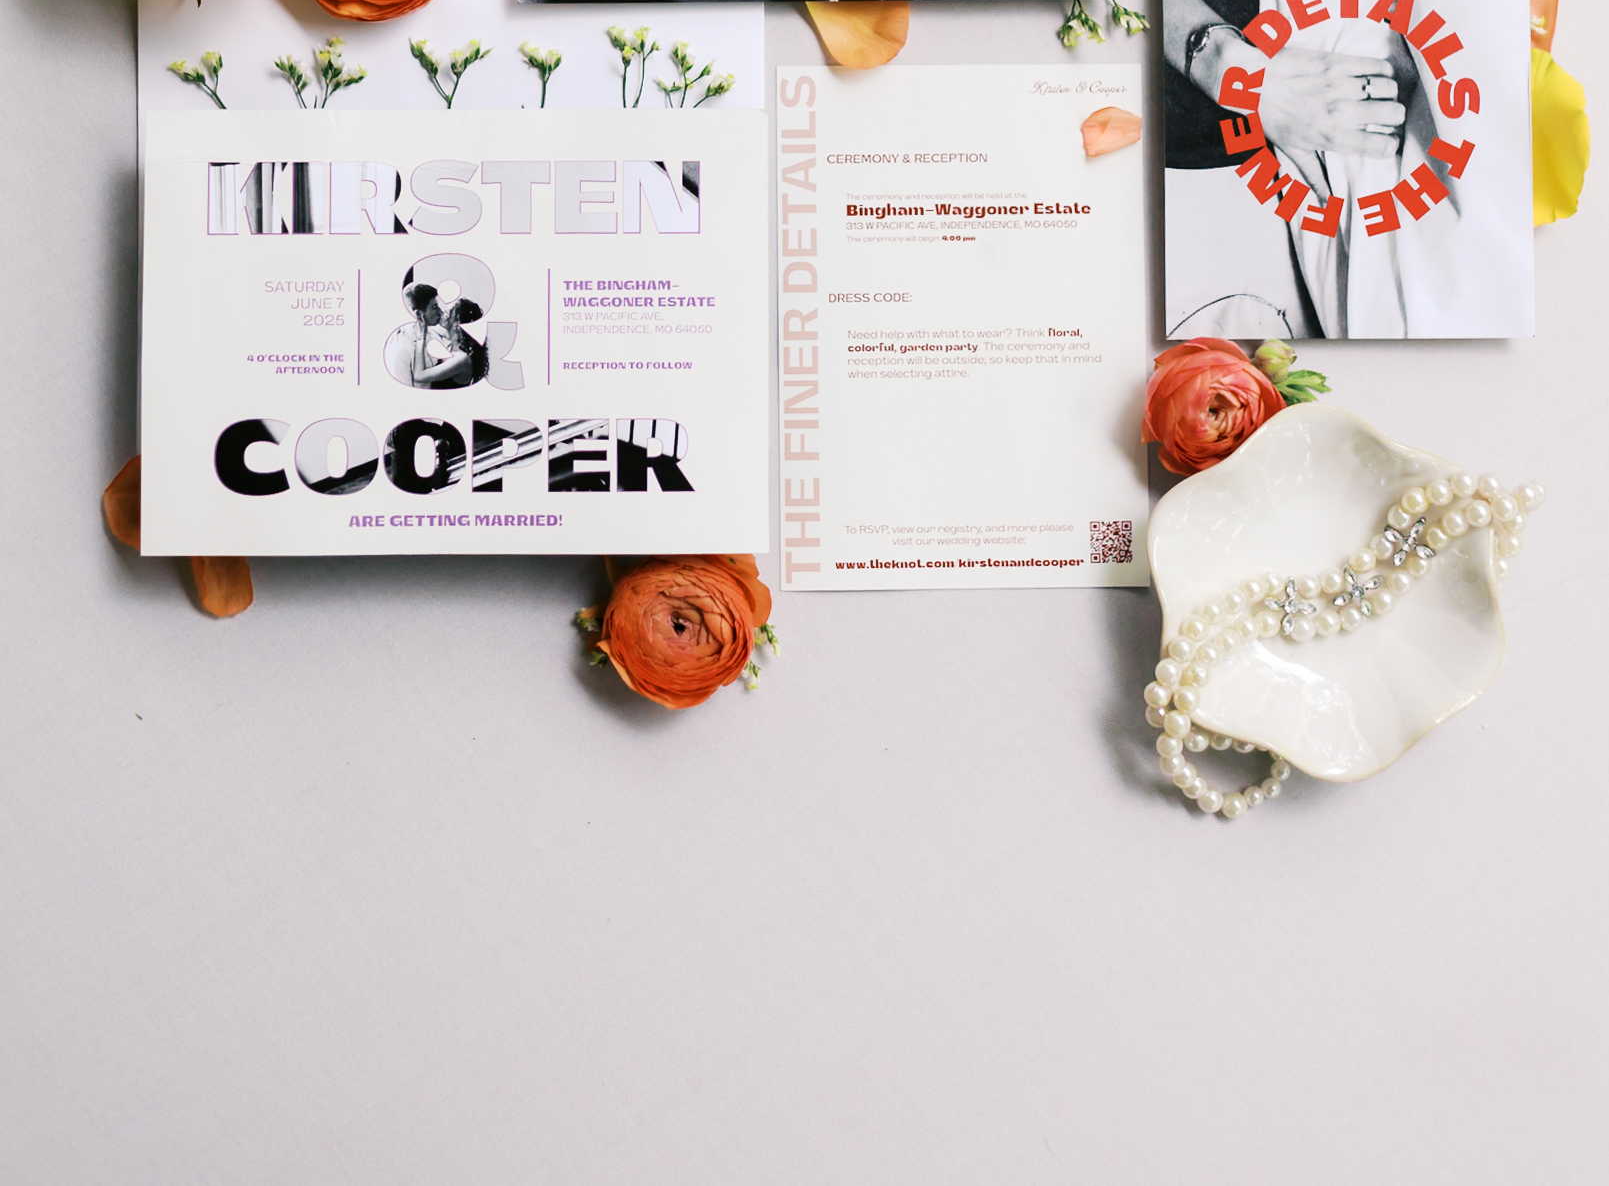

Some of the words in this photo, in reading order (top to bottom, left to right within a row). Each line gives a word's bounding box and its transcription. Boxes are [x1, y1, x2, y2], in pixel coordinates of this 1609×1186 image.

[1029, 81, 1071, 95] Kirsten
[1075, 81, 1087, 94] &
[1089, 80, 1127, 97] Cooper
[1217, 66, 1344, 238] FINER
[827, 154, 899, 164] CEREMONY
[902, 154, 911, 163] &
[914, 153, 988, 163] RECEPTION
[780, 75, 818, 293] DETAILS
[1357, 136, 1475, 237] THE
[206, 159, 700, 235] KIRSTEN
[921, 192, 960, 201] reception
[962, 192, 973, 200] will
[1014, 191, 1027, 199] the
[1034, 202, 1091, 214] Estate
[846, 222, 863, 230] 313
[865, 222, 874, 230] W
[876, 221, 915, 230] PACIFIC
[917, 221, 939, 230] AVE,
[940, 220, 1022, 230] INDEPENDENCE,
[1025, 220, 1041, 229] MO
[1043, 220, 1077, 229] 64050
[863, 236, 903, 244] ceremony
[918, 235, 939, 243] begin
[265, 281, 345, 292] SATURDAY
[563, 281, 593, 290] THE
[291, 298, 332, 309] JUNE
[336, 298, 345, 309] 7
[563, 297, 654, 307] WAGGONER
[658, 297, 715, 307] ESTATE
[829, 293, 870, 303] DRESS
[873, 293, 912, 302] CODE:
[303, 315, 345, 326] 2025
[383, 253, 525, 391] &
[563, 312, 582, 321] 313
[585, 312, 594, 321] W
[596, 312, 638, 321] PACIFIC
[640, 312, 664, 322] AVE,
[563, 325, 652, 335] INDEPENDENCE,
[655, 325, 673, 334] MO
[675, 325, 713, 334] 64050
[848, 331, 878, 339] Need
[880, 330, 904, 341] help
[906, 330, 929, 339] with
[932, 330, 959, 339] what
[962, 330, 974, 338] to
[977, 328, 1012, 338] wear?
[1016, 328, 1045, 338] Think
[1048, 327, 1083, 338] floral,
[848, 343, 897, 353] colorful,
[900, 343, 943, 354] garden
[984, 341, 1005, 351] The
[1006, 343, 1066, 353] ceremony
[1068, 341, 1090, 351] and
[257, 354, 306, 363] O'CLOCK
[848, 356, 904, 366] reception
[906, 356, 922, 365] will
[925, 356, 939, 365] be
[941, 355, 987, 365] outside,
[1005, 355, 1033, 365] keep
[1036, 354, 1059, 364] that
[1061, 354, 1071, 363] in
[1073, 354, 1102, 363] mind
[276, 366, 344, 374] AFTERNOON
[848, 369, 878, 379] when
[880, 369, 932, 380] selecting
[934, 369, 969, 378] attire.
[783, 307, 820, 461] FINER
[214, 418, 695, 496] COOPER
[349, 515, 385, 527] ARE
[389, 515, 470, 527] GETTING
[475, 514, 562, 527] MARRIED!
[784, 477, 821, 583] THE
[845, 526, 857, 534] To
[859, 525, 890, 534] RSVP,
[892, 525, 914, 533] view
[938, 524, 983, 535] registry,
[985, 524, 1005, 532] and
[1039, 523, 1074, 533] please
[892, 537, 913, 545] visit
[936, 536, 981, 546] wedding
[983, 536, 1026, 544] website:
